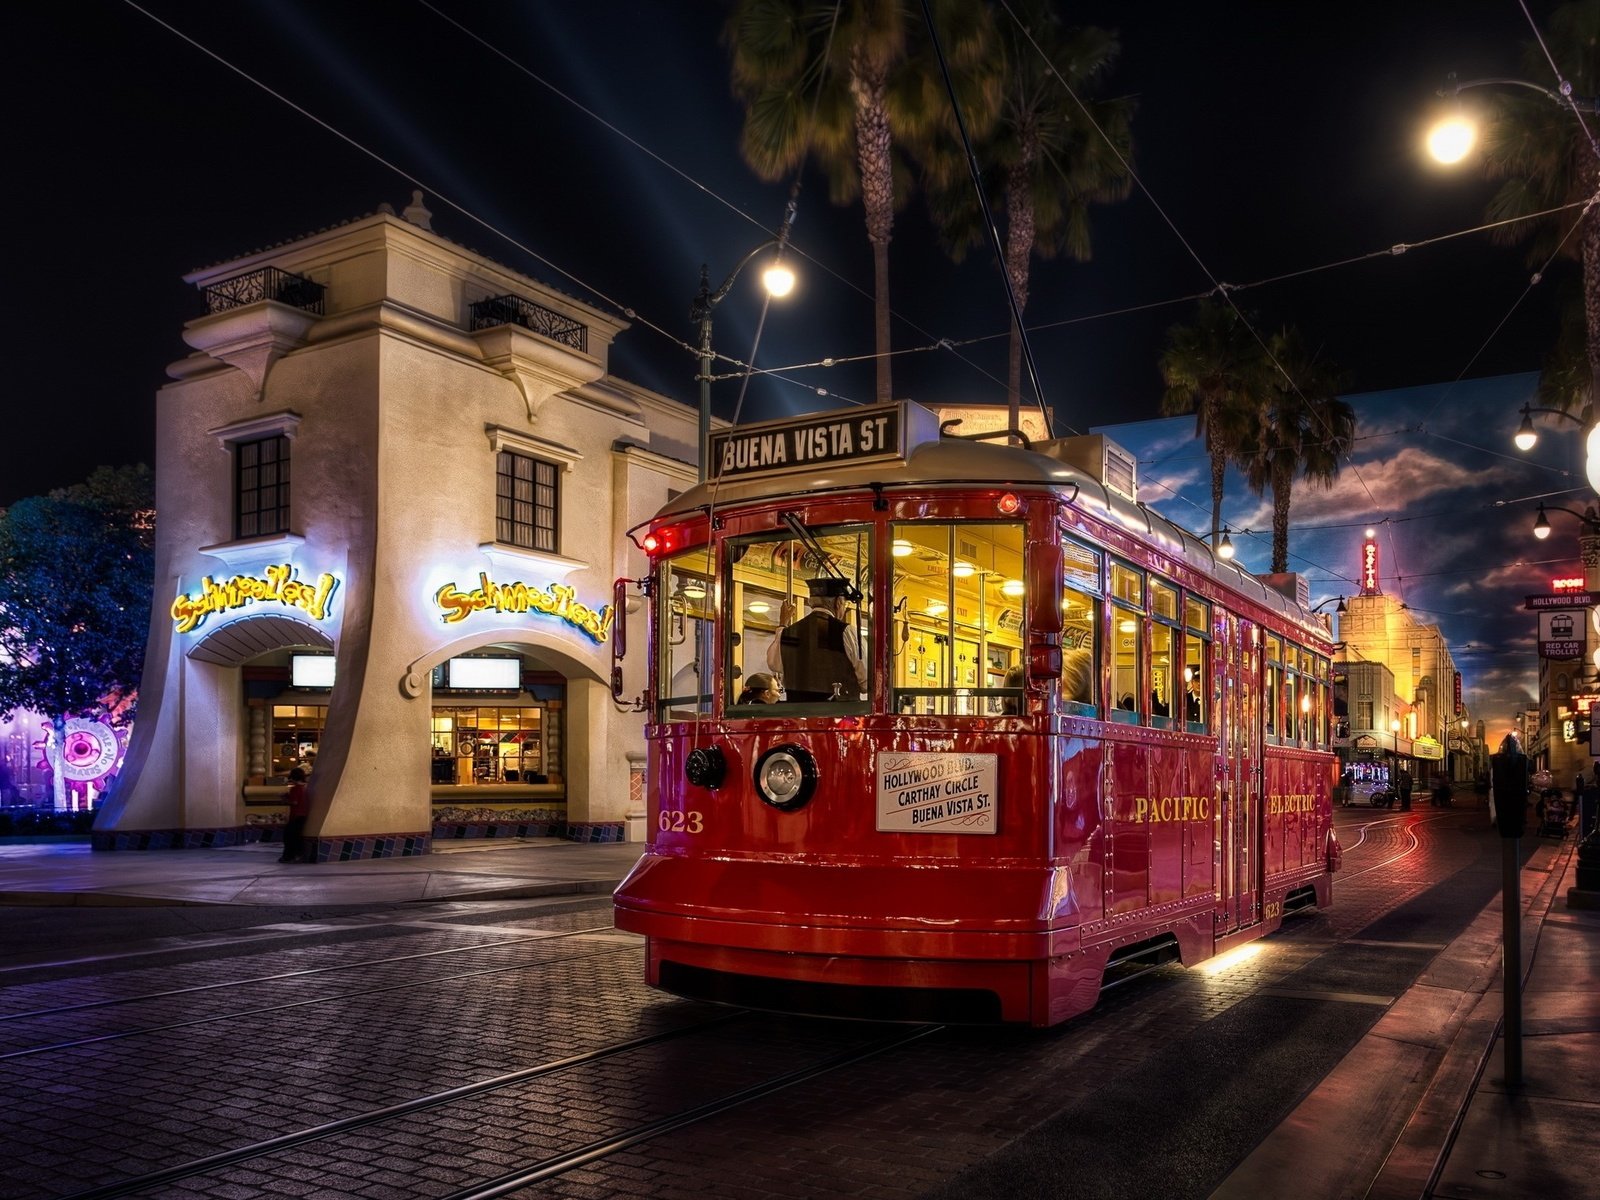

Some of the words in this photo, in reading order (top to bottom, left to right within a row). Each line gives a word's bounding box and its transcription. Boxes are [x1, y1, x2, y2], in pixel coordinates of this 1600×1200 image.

[723, 433, 787, 471] BUENA
[794, 422, 853, 461] VISTA
[860, 417, 888, 451] ST
[1533, 596, 1571, 606] HOLLYWOOD
[1545, 648, 1579, 656] TROLLEY
[884, 763, 944, 790] HOLLYWOOD
[946, 757, 974, 775] BLVD.
[898, 784, 941, 807] CARTHAY
[945, 775, 979, 796] CIRCLE
[912, 808, 944, 825] BUENA
[947, 798, 974, 816] VISTA
[977, 793, 991, 810] ST.
[1135, 796, 1209, 823] PACIFIC
[1270, 794, 1316, 815] ELECTRIC
[658, 810, 704, 834] 623
[1265, 902, 1280, 920] 623
